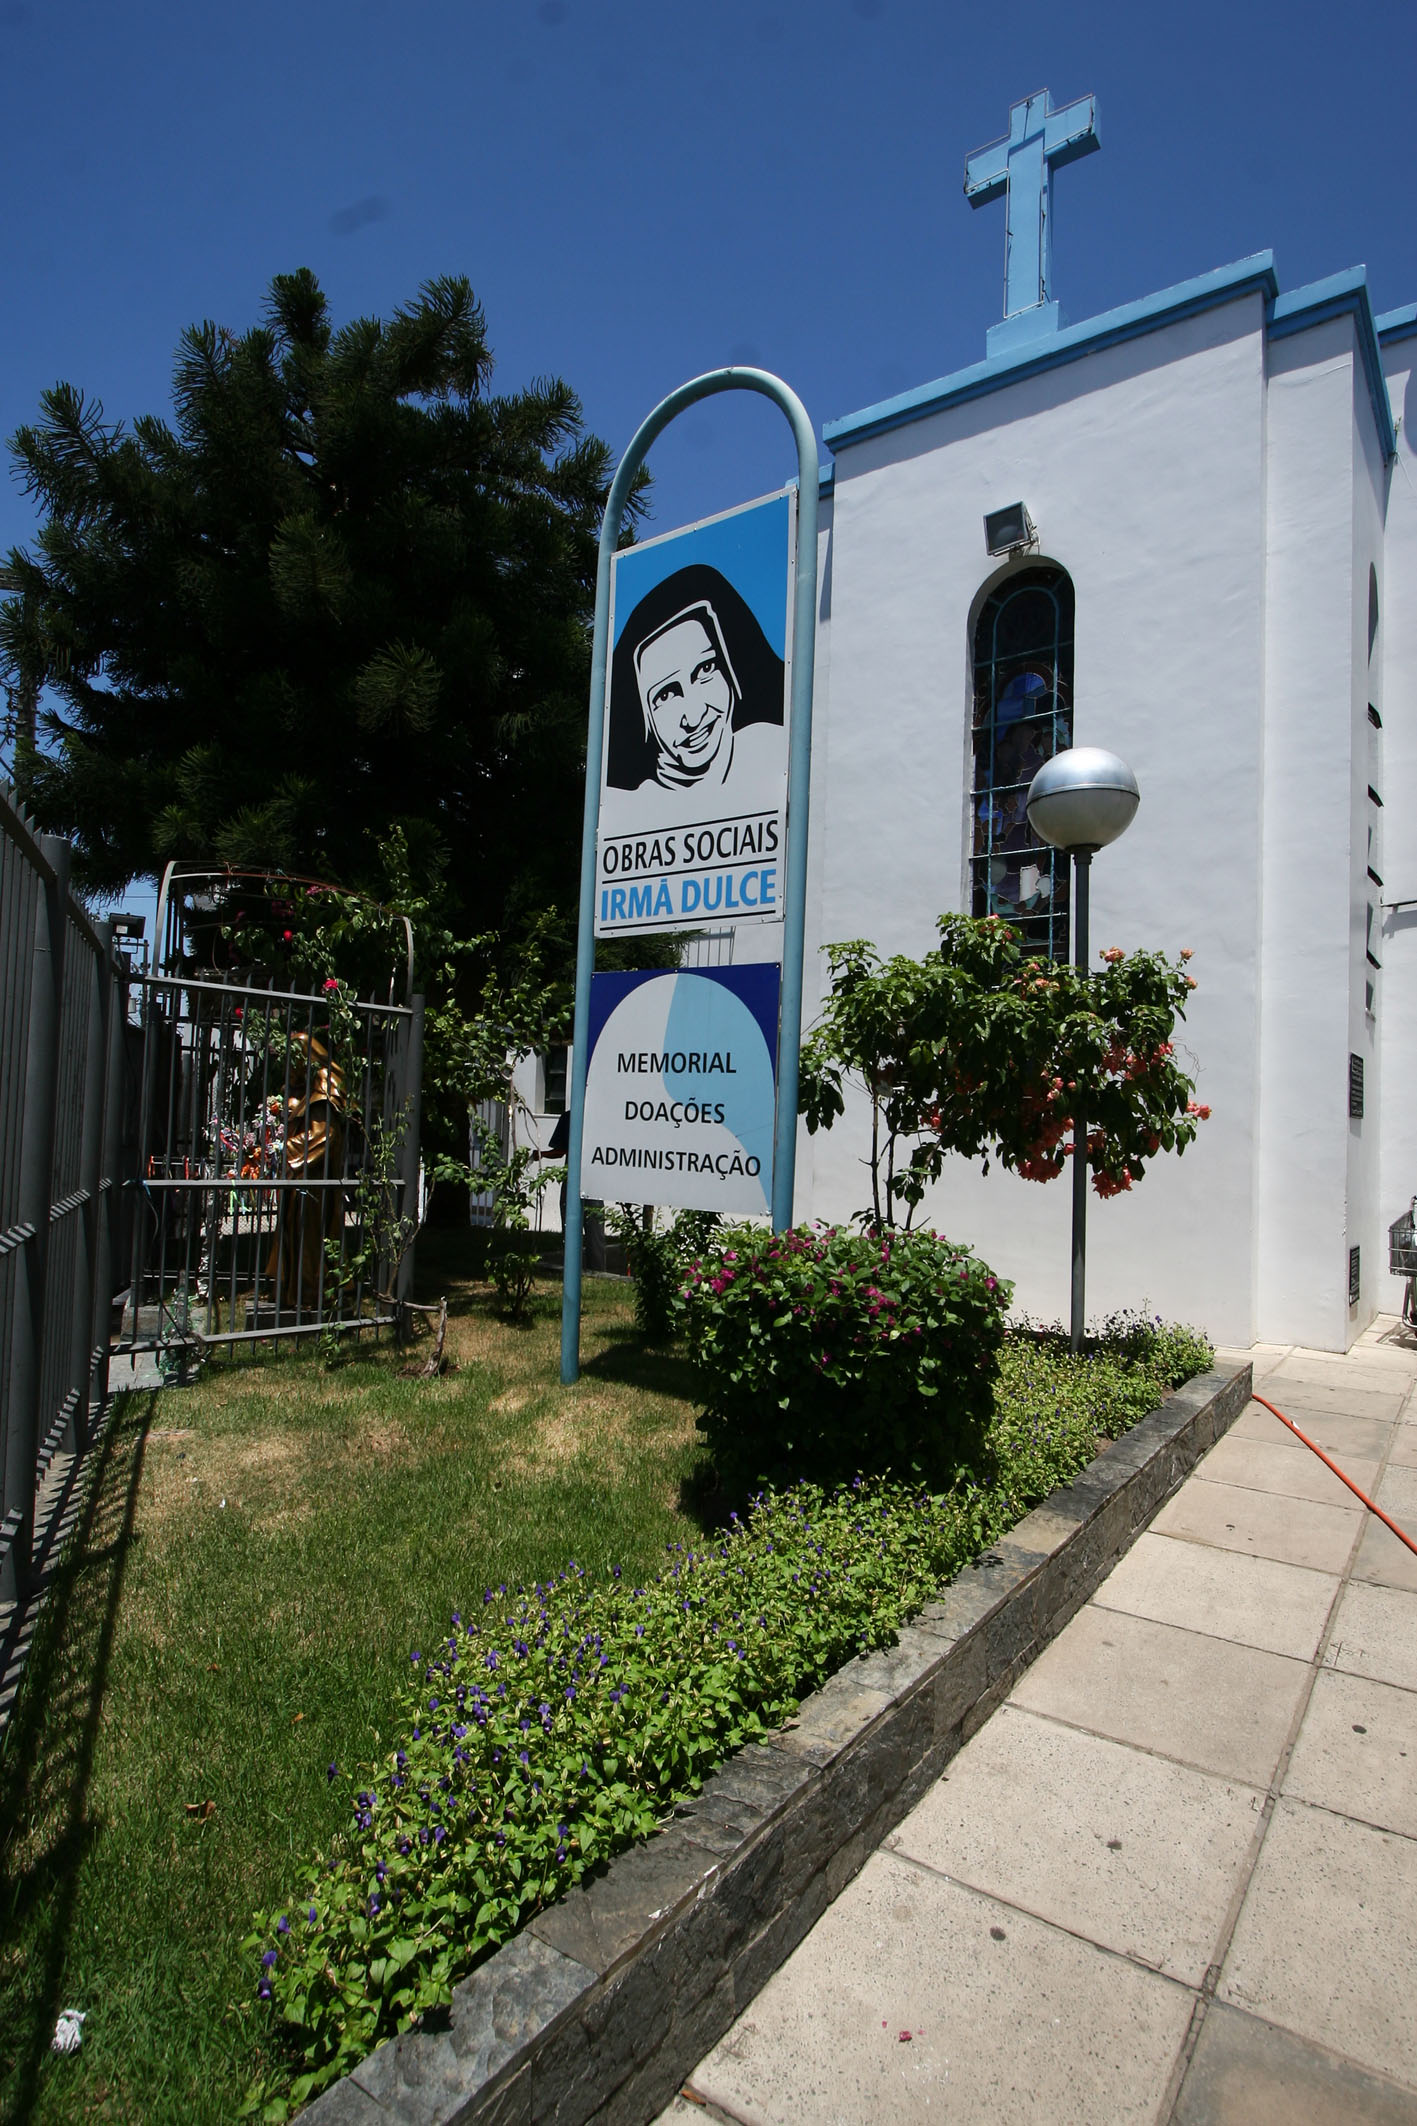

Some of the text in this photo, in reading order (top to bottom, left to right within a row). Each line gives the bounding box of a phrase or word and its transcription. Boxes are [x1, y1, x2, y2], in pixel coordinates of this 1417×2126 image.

[603, 820, 779, 874] OBRAS SOCIAIS
[601, 868, 777, 921] IRMÃ DULCE
[617, 1052, 737, 1074] MEMORIAL
[624, 1097, 725, 1129] DOAÇÕES
[591, 1147, 761, 1181] ADMINISTRAÇÃO
